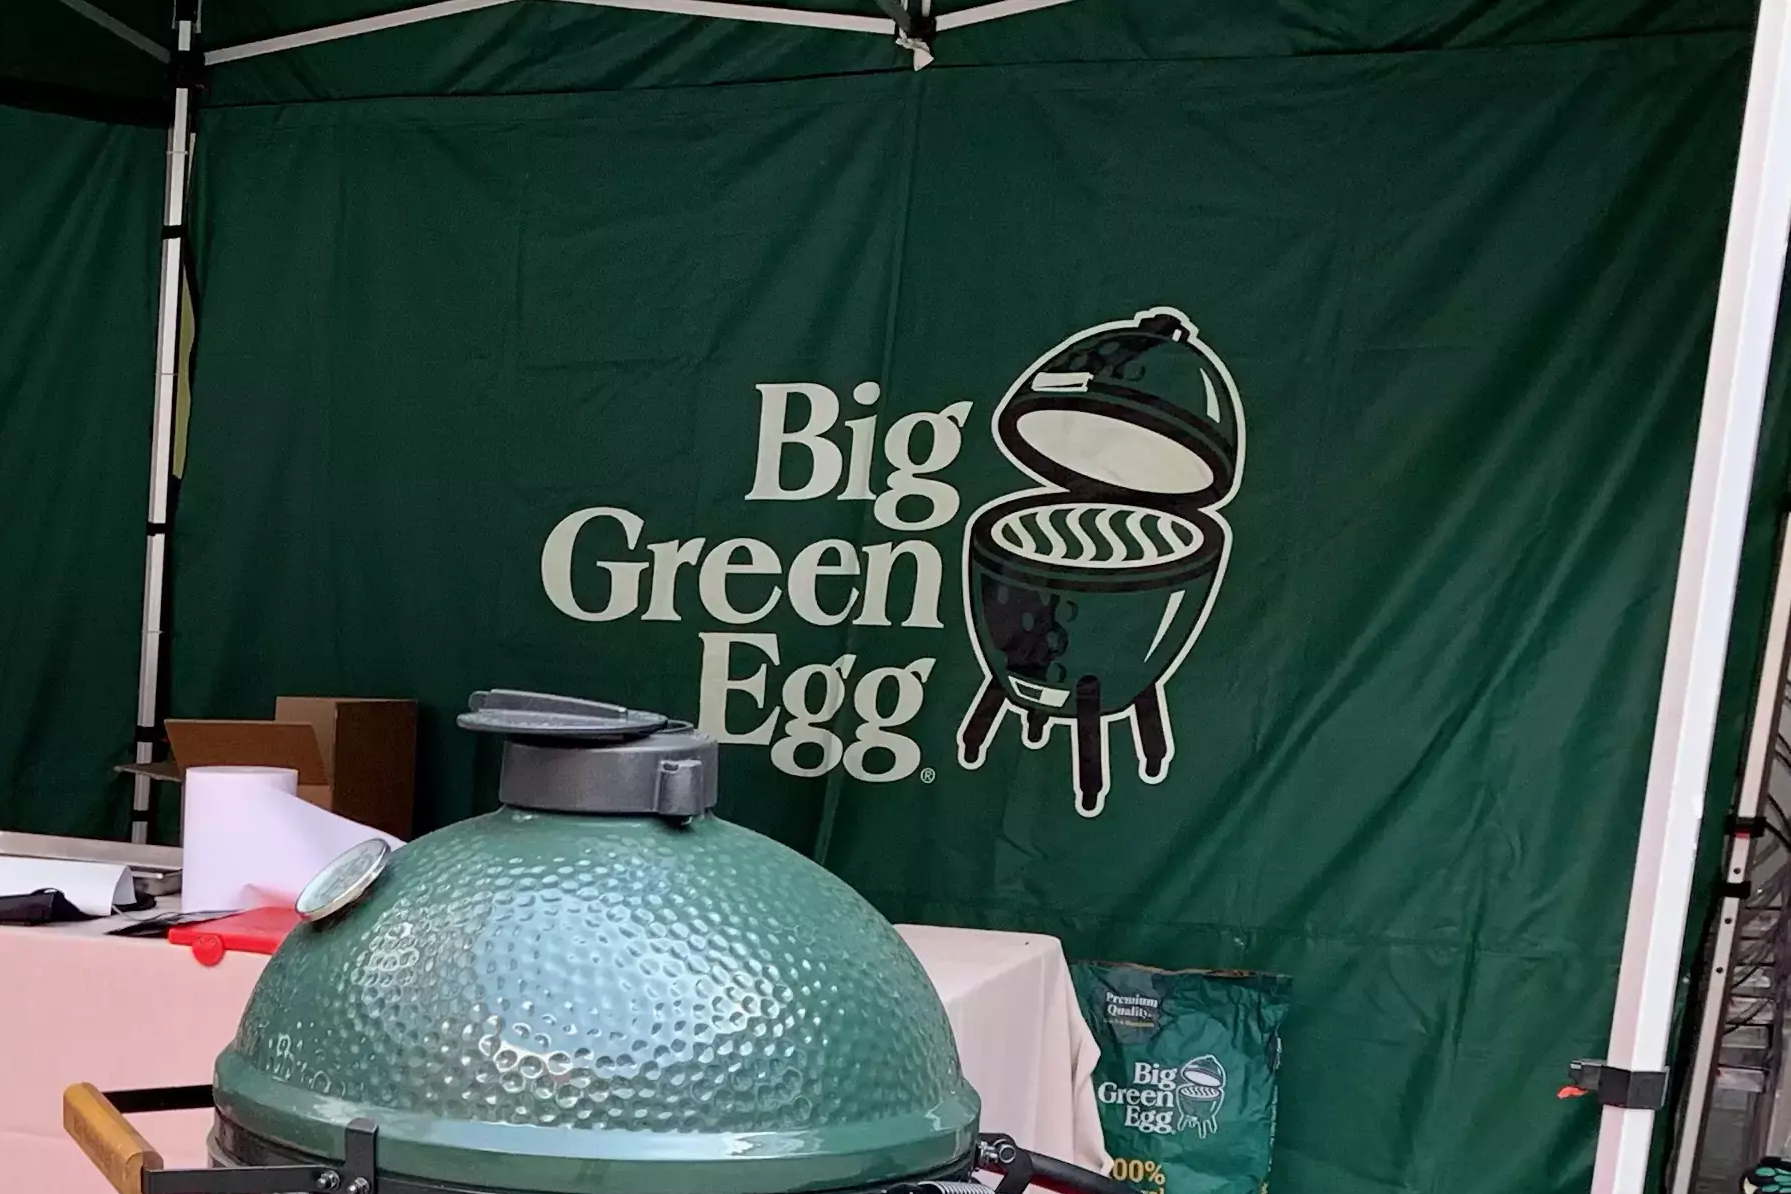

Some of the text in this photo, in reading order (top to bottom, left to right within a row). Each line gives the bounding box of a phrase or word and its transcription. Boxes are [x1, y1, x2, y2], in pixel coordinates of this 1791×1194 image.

[744, 381, 973, 531] Big
[541, 506, 944, 629] Green
[1106, 992, 1158, 1008] Premium
[1133, 1062, 1178, 1091] Big
[1097, 1082, 1174, 1108] Green
[1113, 1158, 1166, 1185] 00%
